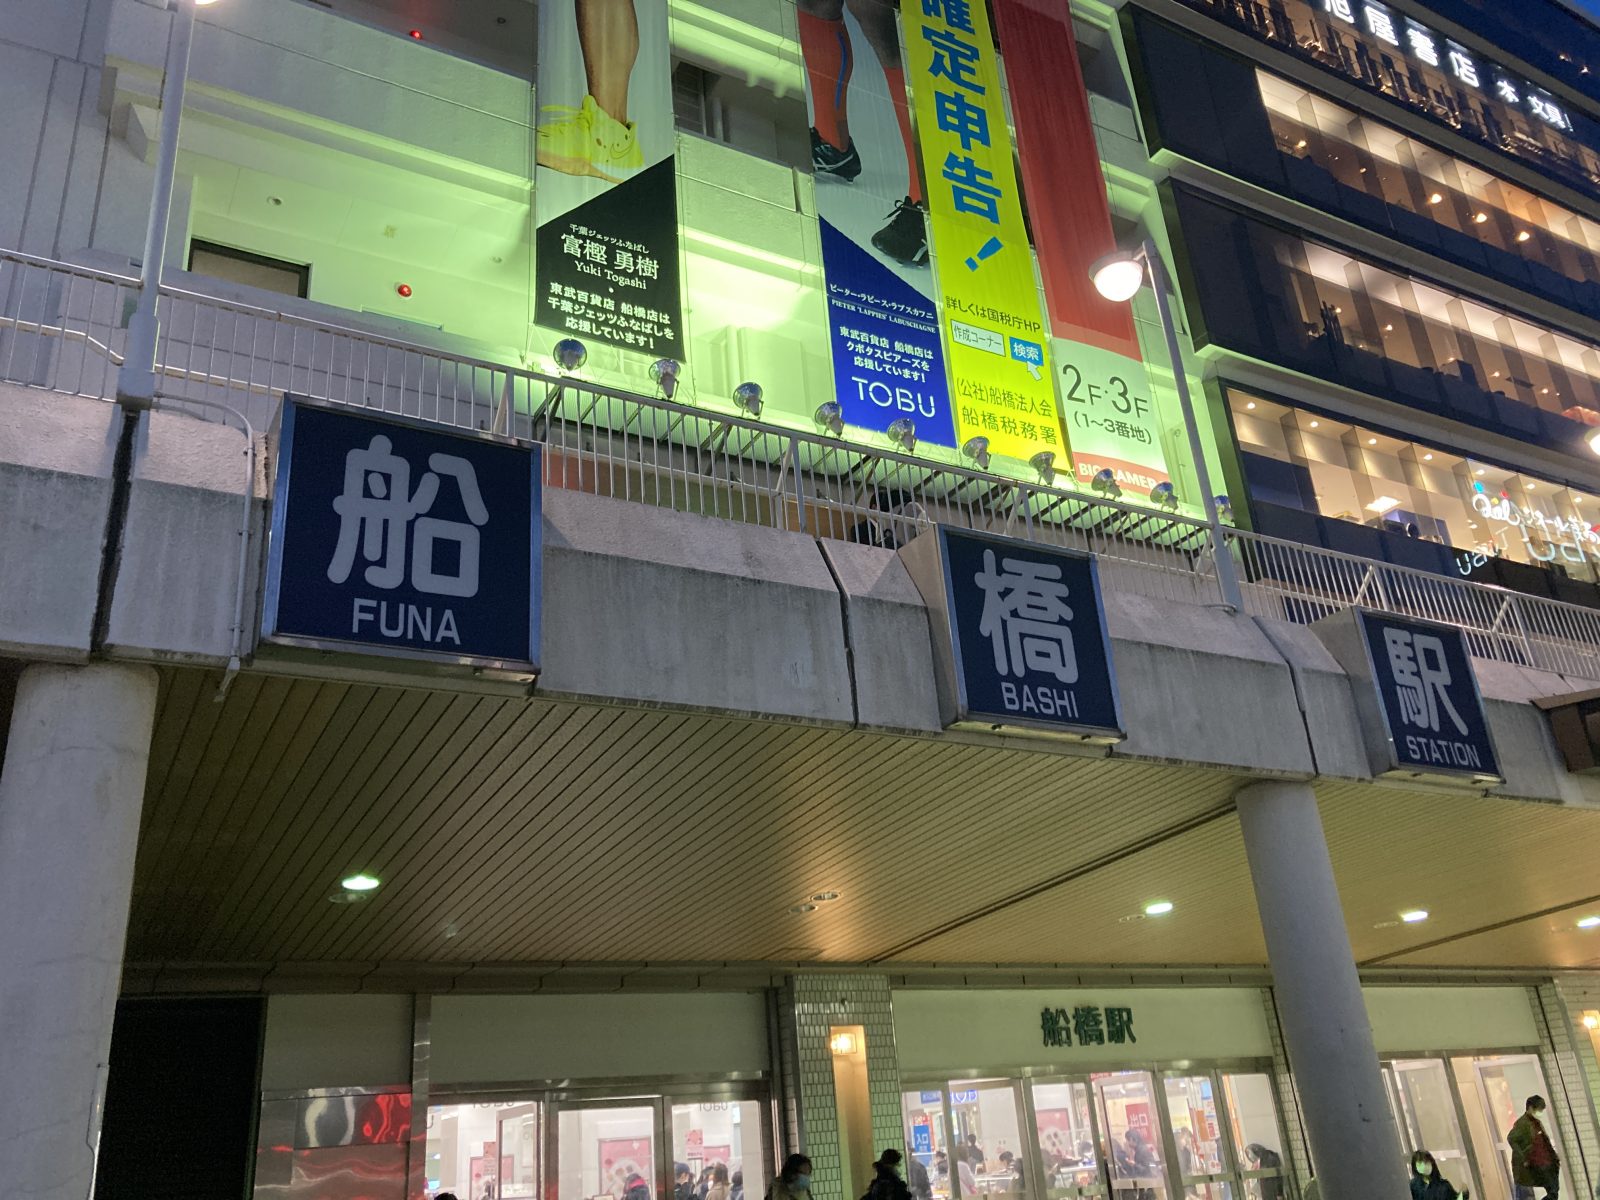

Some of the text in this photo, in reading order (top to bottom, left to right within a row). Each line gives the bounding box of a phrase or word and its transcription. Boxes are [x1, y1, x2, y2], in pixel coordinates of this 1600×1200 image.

[561, 233, 660, 280] 富樫 勇樹
[570, 223, 650, 254] 千葉ジェッツふなばし
[574, 260, 647, 290] Yuki Togashi
[547, 296, 675, 340] 千葉ジェッツふなばしを
[550, 282, 671, 324] 東武百貨店 船橋店は
[831, 298, 857, 312] PIETER
[888, 315, 937, 334] LABUSCHAGNE
[945, 295, 1041, 333] 詳しくは国税庁HP
[840, 326, 934, 360] 東武百貨店 船橋店は
[846, 341, 930, 371] クボタスピアーズを
[953, 325, 1003, 348] 作成コーナー
[1013, 342, 1040, 361] 検索
[851, 376, 936, 418] TOBU
[956, 377, 1052, 418] (公社)船橋法人会
[962, 406, 1057, 445] 船橋税務署
[327, 434, 489, 598] 船
[352, 598, 461, 645] FUNA
[974, 549, 1078, 684] 橋
[1000, 681, 1079, 718] BASHI
[1383, 626, 1469, 736] 駅
[1406, 735, 1482, 768] STATION
[1040, 1006, 1137, 1047] 船橋駅
